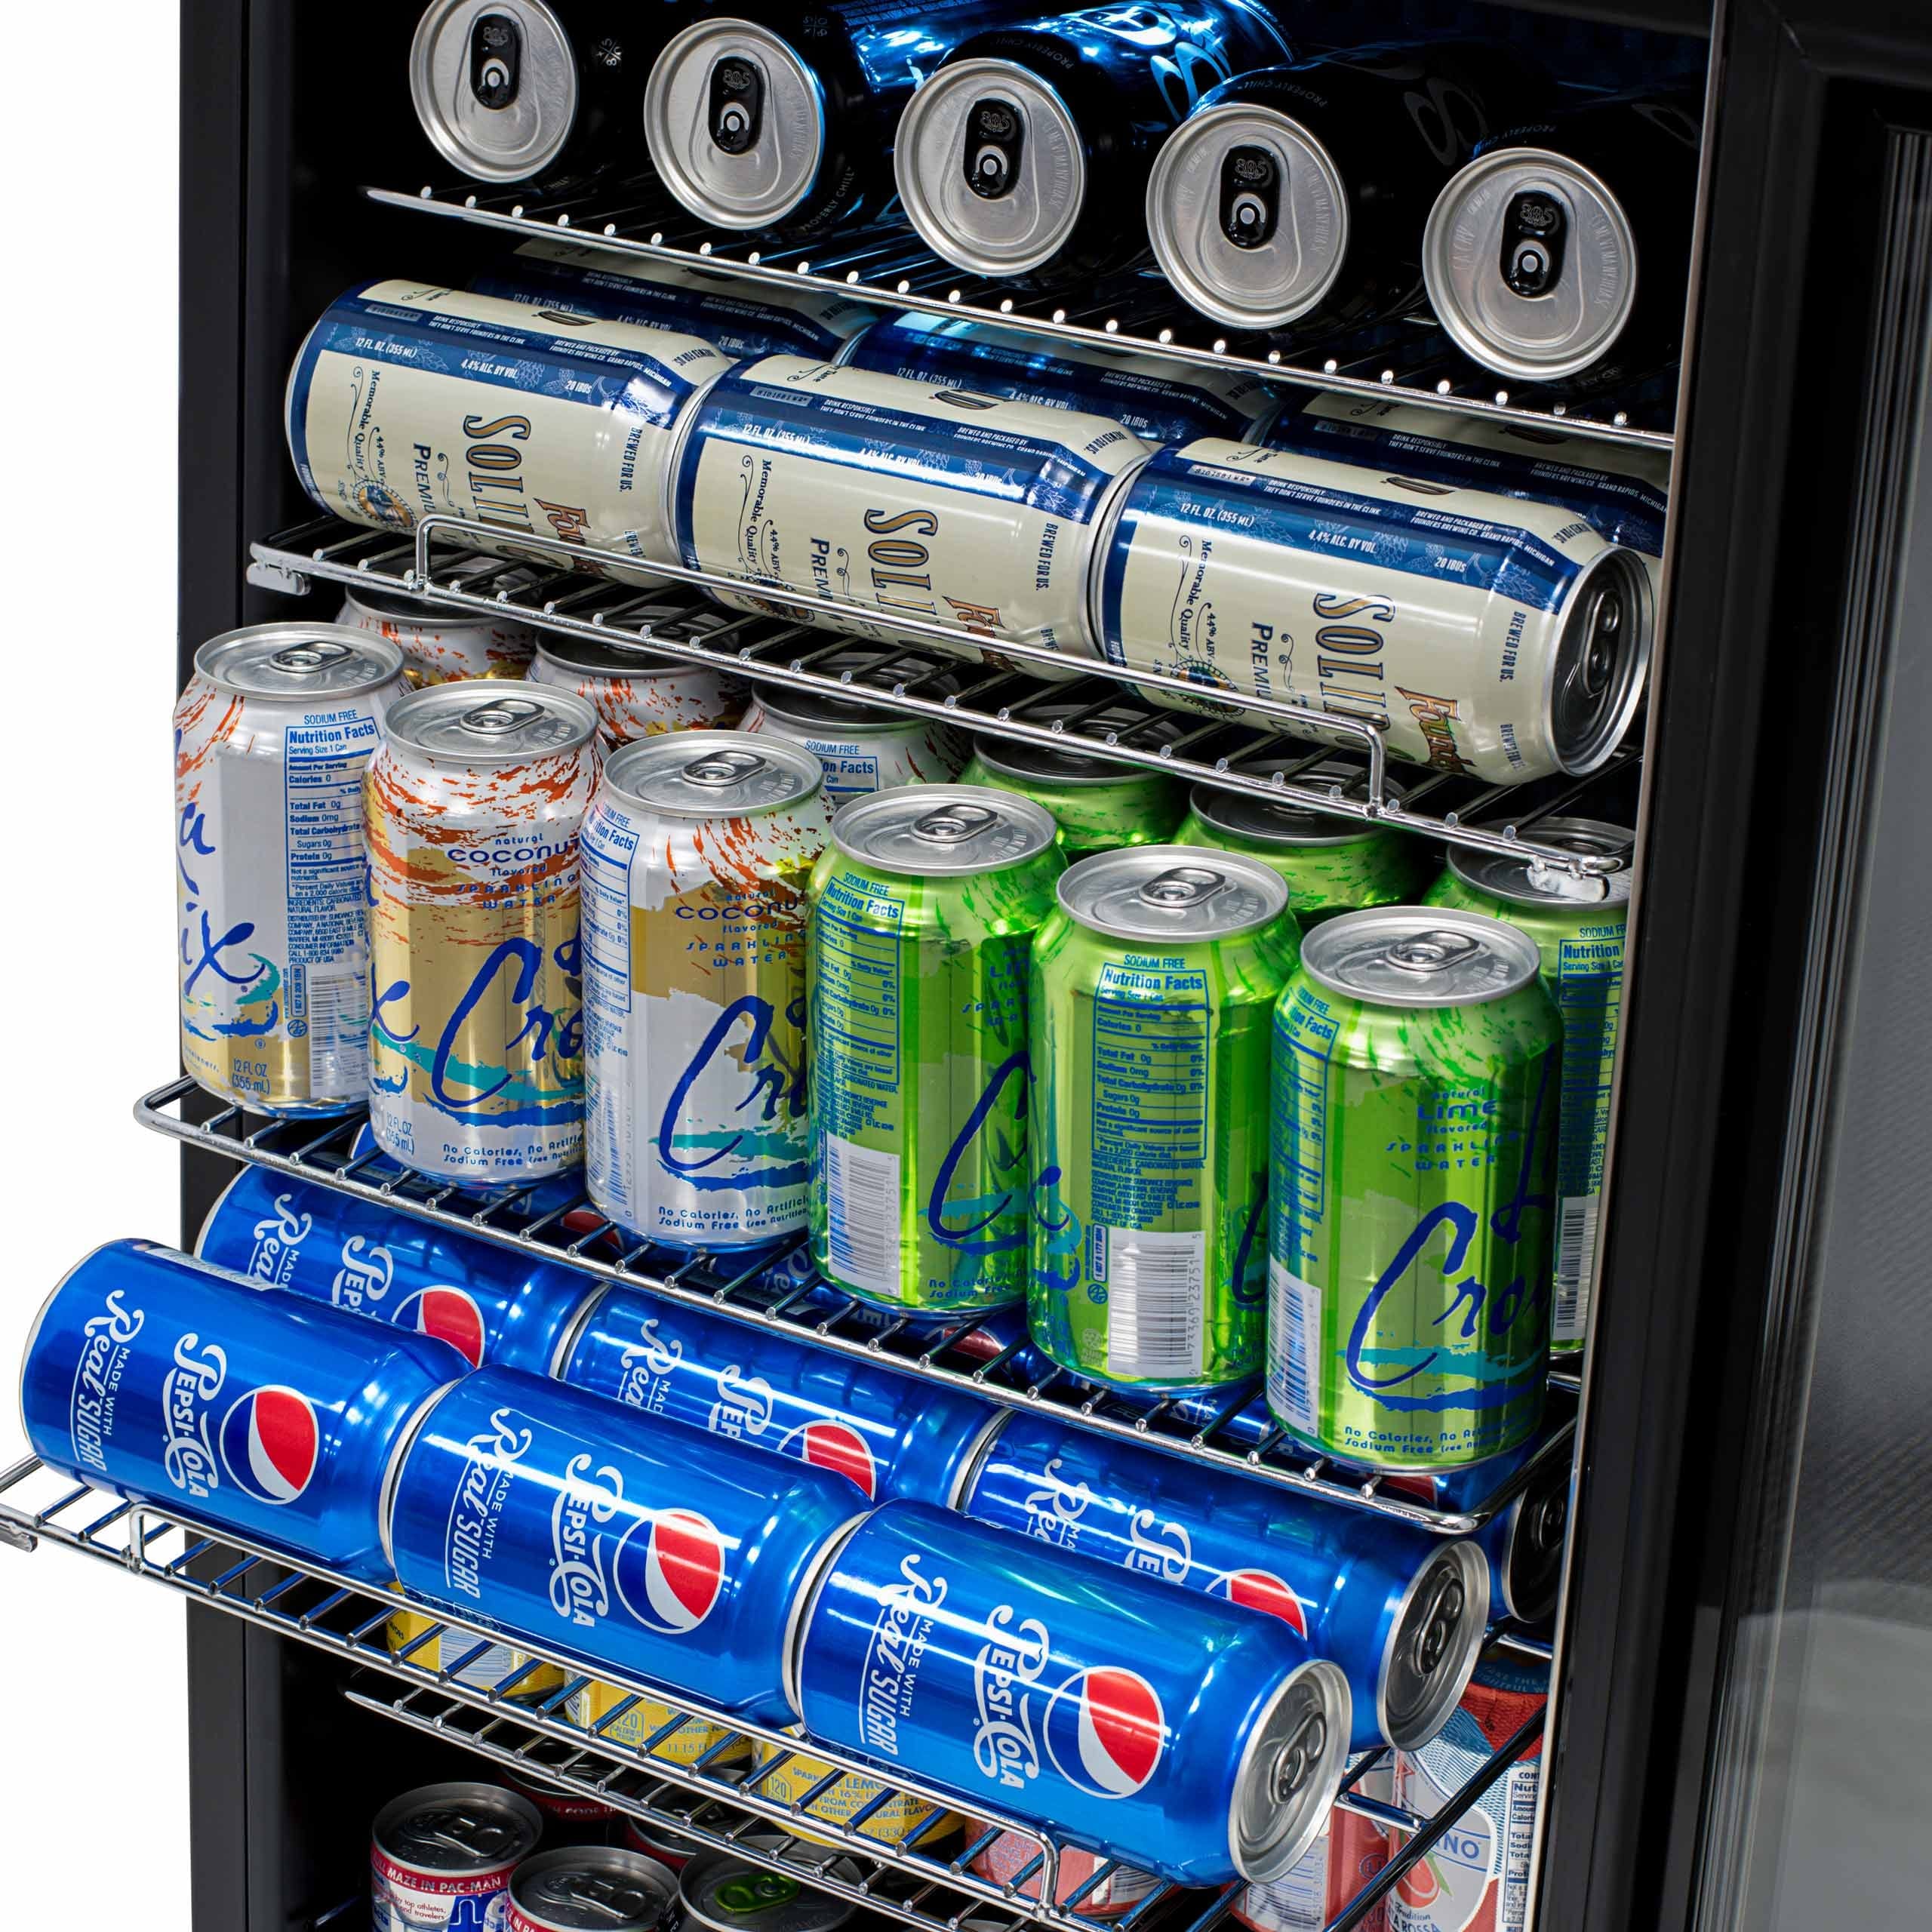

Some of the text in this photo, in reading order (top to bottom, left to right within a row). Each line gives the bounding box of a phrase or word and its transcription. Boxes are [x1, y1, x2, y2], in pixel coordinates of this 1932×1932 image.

[354, 371, 380, 472] Memorable Quality
[621, 427, 643, 481] BREWED FOR
[745, 459, 772, 565] Memorable Quality
[1180, 503, 1190, 514] 12
[1192, 505, 1201, 517] FL.
[1203, 507, 1217, 520] OZ.
[1217, 510, 1237, 524] (355
[1039, 522, 1059, 558] BREWED
[1309, 530, 1330, 544] 4.4%
[1349, 537, 1360, 549] BY
[864, 509, 938, 615] SOLI
[1435, 556, 1444, 568] 20
[1524, 543, 1555, 567] MICHIGAN
[811, 537, 834, 599] PREMI
[1038, 559, 1051, 575] FOR
[1178, 608, 1193, 651] Quality
[1504, 611, 1527, 652] BREWED
[1502, 651, 1518, 669] FOR
[304, 709, 358, 724] SODIUM FREE
[289, 724, 376, 743] Nutrition Facts
[289, 746, 313, 755] Serving
[804, 740, 860, 755] SODIUM FREE
[840, 760, 874, 774] Facts
[615, 813, 631, 828] FREE
[495, 833, 544, 845] natural
[608, 829, 635, 851] Facts
[491, 864, 546, 876] flavored
[843, 872, 889, 897] SODIUM FREE
[726, 888, 777, 901] natural
[826, 882, 899, 919] Nutrition Facts
[676, 897, 798, 920] COCONU
[723, 921, 779, 934] flavored
[1579, 926, 1614, 938] SODIUM
[1564, 943, 1620, 959] Nutrition
[1124, 954, 1186, 969] SODIUM FREE
[1104, 969, 1203, 990] Nutrition Facts
[1312, 998, 1331, 1014] FREE
[1305, 1017, 1333, 1040] Facts
[254, 1063, 267, 1077] OZ
[443, 1143, 457, 1154] No
[528, 1145, 543, 1154] No
[495, 1157, 523, 1166] Free
[659, 1206, 673, 1217] No
[746, 1208, 761, 1217] No
[712, 1220, 739, 1229] Free
[76, 1290, 144, 1472] Real SUGAR
[103, 1347, 130, 1435] MADE WITH
[1345, 1426, 1361, 1437] No
[1440, 1432, 1457, 1441] No
[1402, 1444, 1433, 1454] Free
[452, 1407, 532, 1599] Real SUGAR
[481, 1518, 499, 1559] WITH
[866, 1554, 948, 1756] Real SUGAR
[900, 1620, 934, 1718] MADE WITH
[387, 1867, 501, 1894] MAZE IN PAC-MAN
